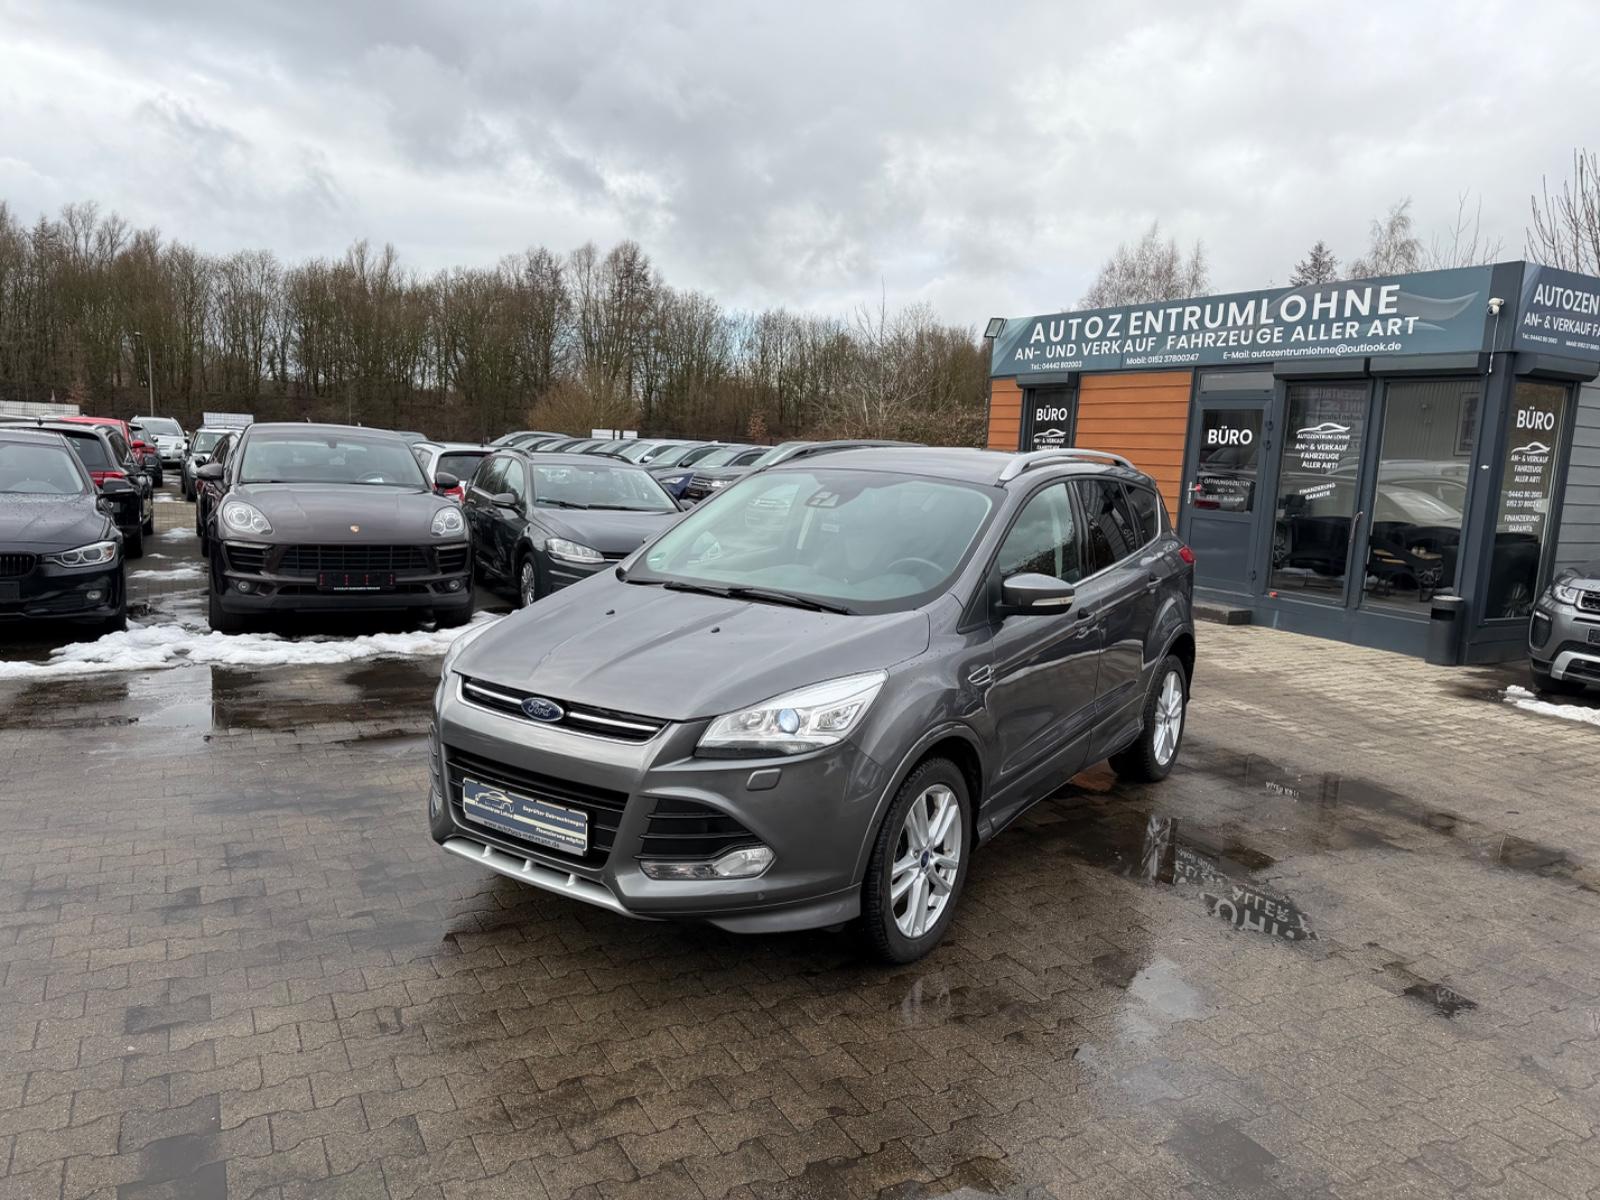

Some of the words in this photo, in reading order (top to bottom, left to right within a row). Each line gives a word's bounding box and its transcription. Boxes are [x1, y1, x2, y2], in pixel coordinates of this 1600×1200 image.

[1533, 283, 1600, 315] AUTOZEN
[1524, 312, 1542, 327] AN-
[1544, 315, 1551, 329] &
[1553, 316, 1592, 335] VERKAUF
[1014, 347, 1040, 361] AN-
[1046, 344, 1077, 358] UND
[1081, 337, 1157, 356] VERKAUF
[1166, 326, 1284, 350] FAHRZEUGE
[1290, 321, 1358, 342] ALLER
[1367, 316, 1419, 337] ART
[1251, 342, 1402, 358] autozentrumlohne@outlook.de
[1147, 355, 1163, 364] 0152
[1164, 353, 1199, 363] 37800247
[1036, 404, 1067, 421] BÜRO
[1517, 406, 1554, 431] BÜRO
[1207, 425, 1253, 445] BÜRO
[1300, 452, 1340, 460] FAHRZEUGE
[1526, 455, 1549, 464] VERKAUF
[1514, 465, 1543, 474] FAHRZEUGE
[1514, 475, 1529, 483] ALLER
[1299, 483, 1336, 495] FINANZIERUNG
[1504, 514, 1540, 523] FINANZIERUNG
[528, 700, 552, 717] Ford
